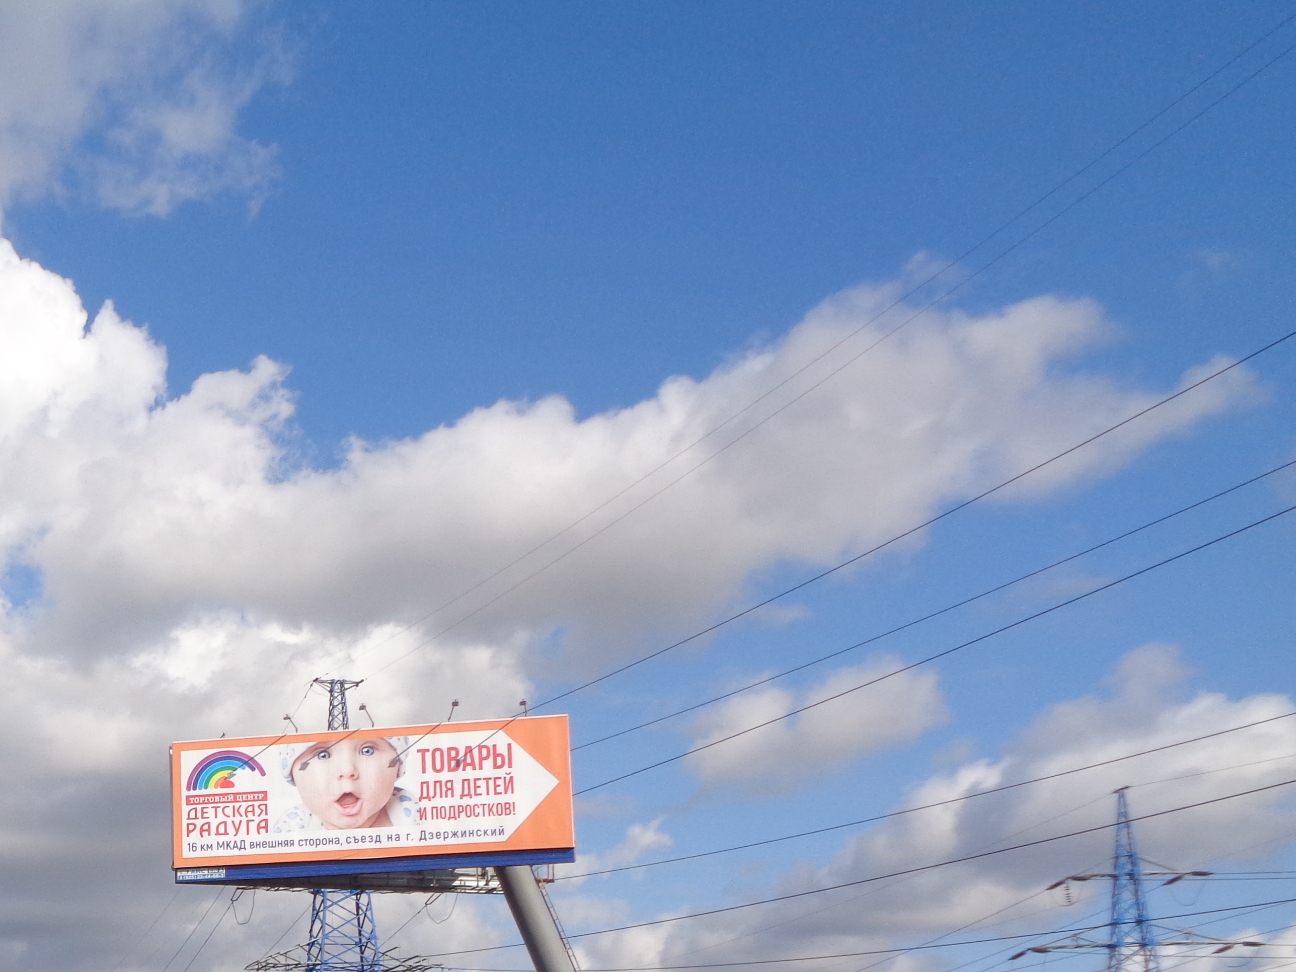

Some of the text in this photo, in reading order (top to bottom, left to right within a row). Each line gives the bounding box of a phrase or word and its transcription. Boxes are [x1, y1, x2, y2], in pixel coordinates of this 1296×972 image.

[416, 743, 513, 774] ТОВАРЫ
[418, 771, 515, 802] ДЛЯ ДЕТЕЙ
[189, 793, 265, 804] ТОРГОВЫЙ ЦЕНТР
[185, 803, 268, 821] ДЕТСКАЯ
[418, 802, 516, 821] И ПОДРОСТКОВ!
[186, 818, 269, 838] РАДУГА
[187, 825, 506, 852] 16 км МКАД внешняя сторона, съезд на г. Дзержинский
